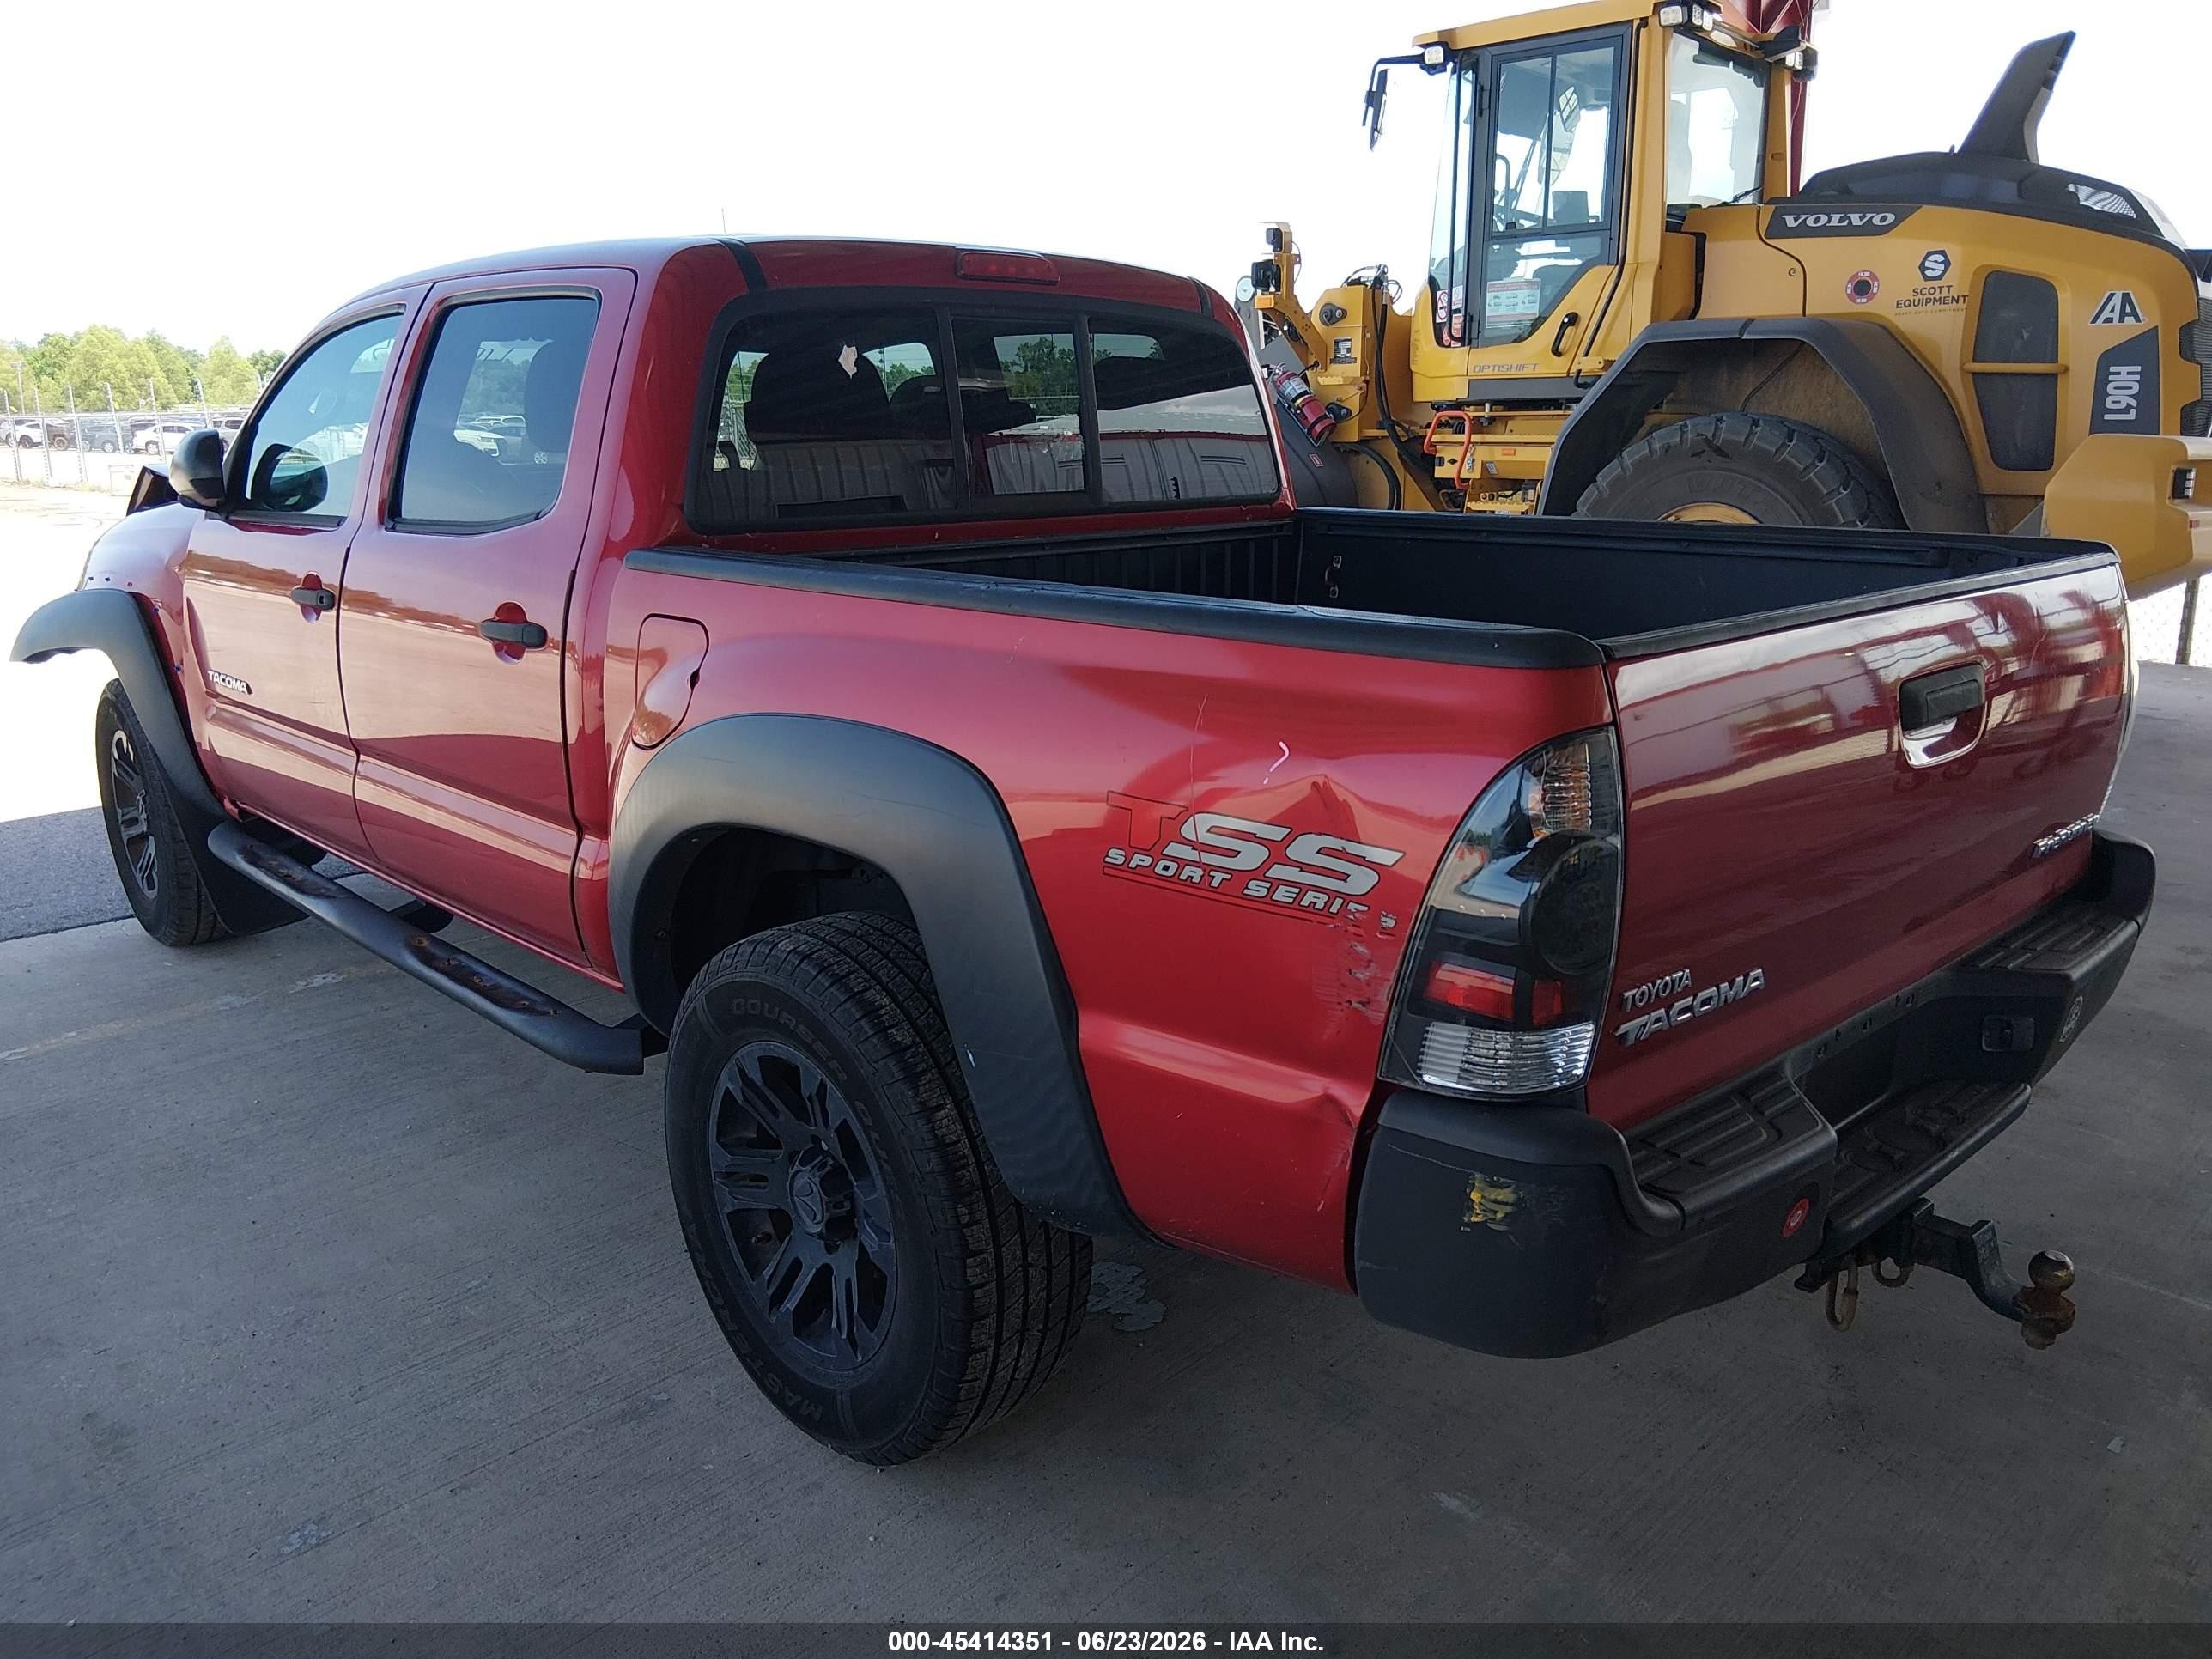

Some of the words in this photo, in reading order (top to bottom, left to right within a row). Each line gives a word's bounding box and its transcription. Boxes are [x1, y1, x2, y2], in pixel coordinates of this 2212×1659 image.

[1783, 213, 1896, 228] VOLVO
[1895, 295, 1969, 309] EQUIPMENT
[1912, 284, 1953, 297] SCOTT
[1473, 363, 1539, 373] OPTISHIFT
[2103, 365, 2142, 421] L90H
[207, 670, 248, 695] TACOMA
[1103, 847, 1232, 889] SPORT
[1620, 968, 1692, 1012] TOYOTA
[1613, 968, 1765, 1048] TACOMA
[731, 998, 848, 1082] COURSER
